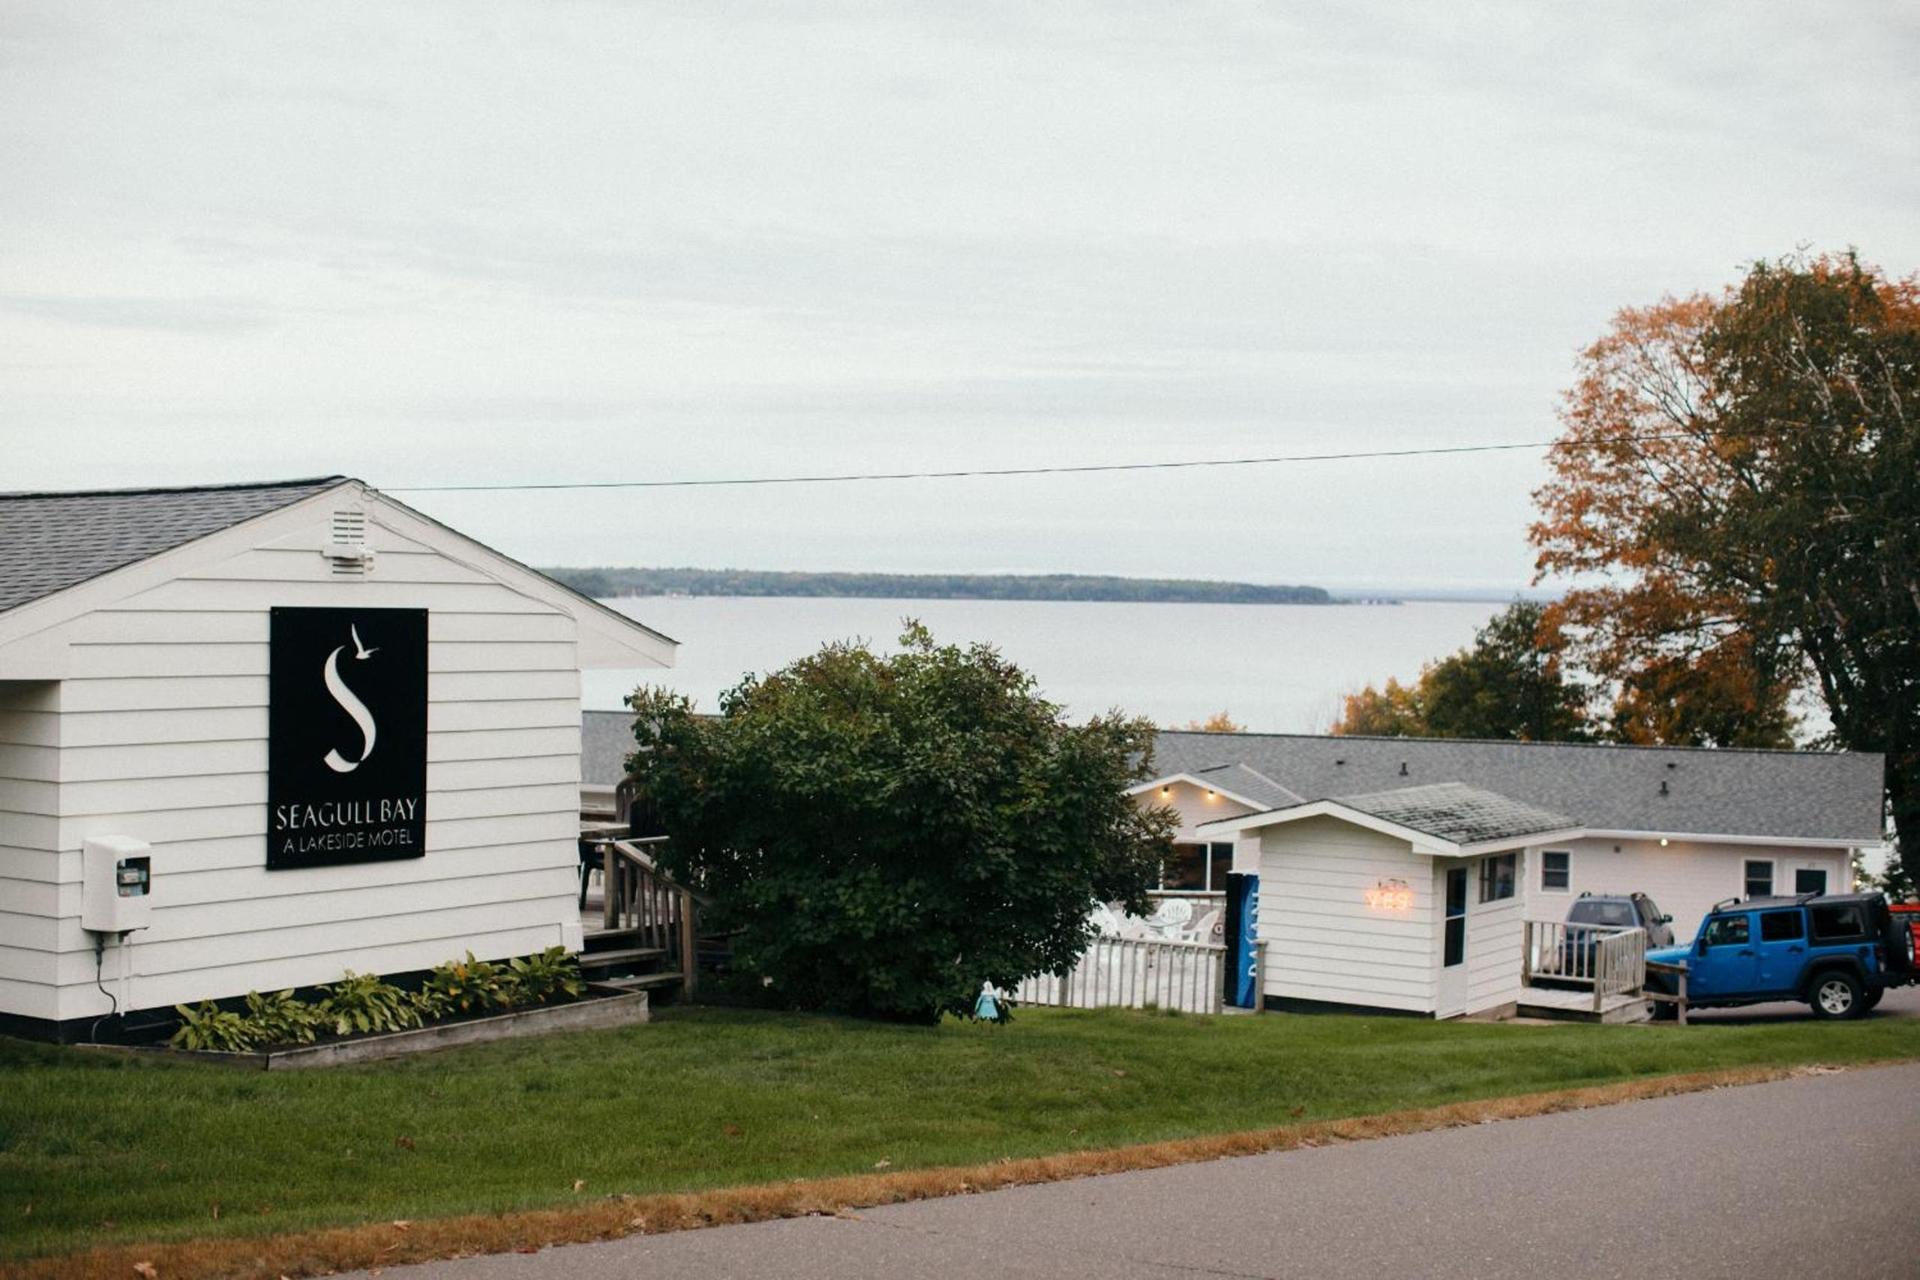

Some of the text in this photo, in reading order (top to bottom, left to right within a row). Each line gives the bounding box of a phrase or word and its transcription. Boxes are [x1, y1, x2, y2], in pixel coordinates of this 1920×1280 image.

[276, 798, 418, 830] SEAGULL BAY
[283, 828, 413, 854] A LAKESIDE MOTEL
